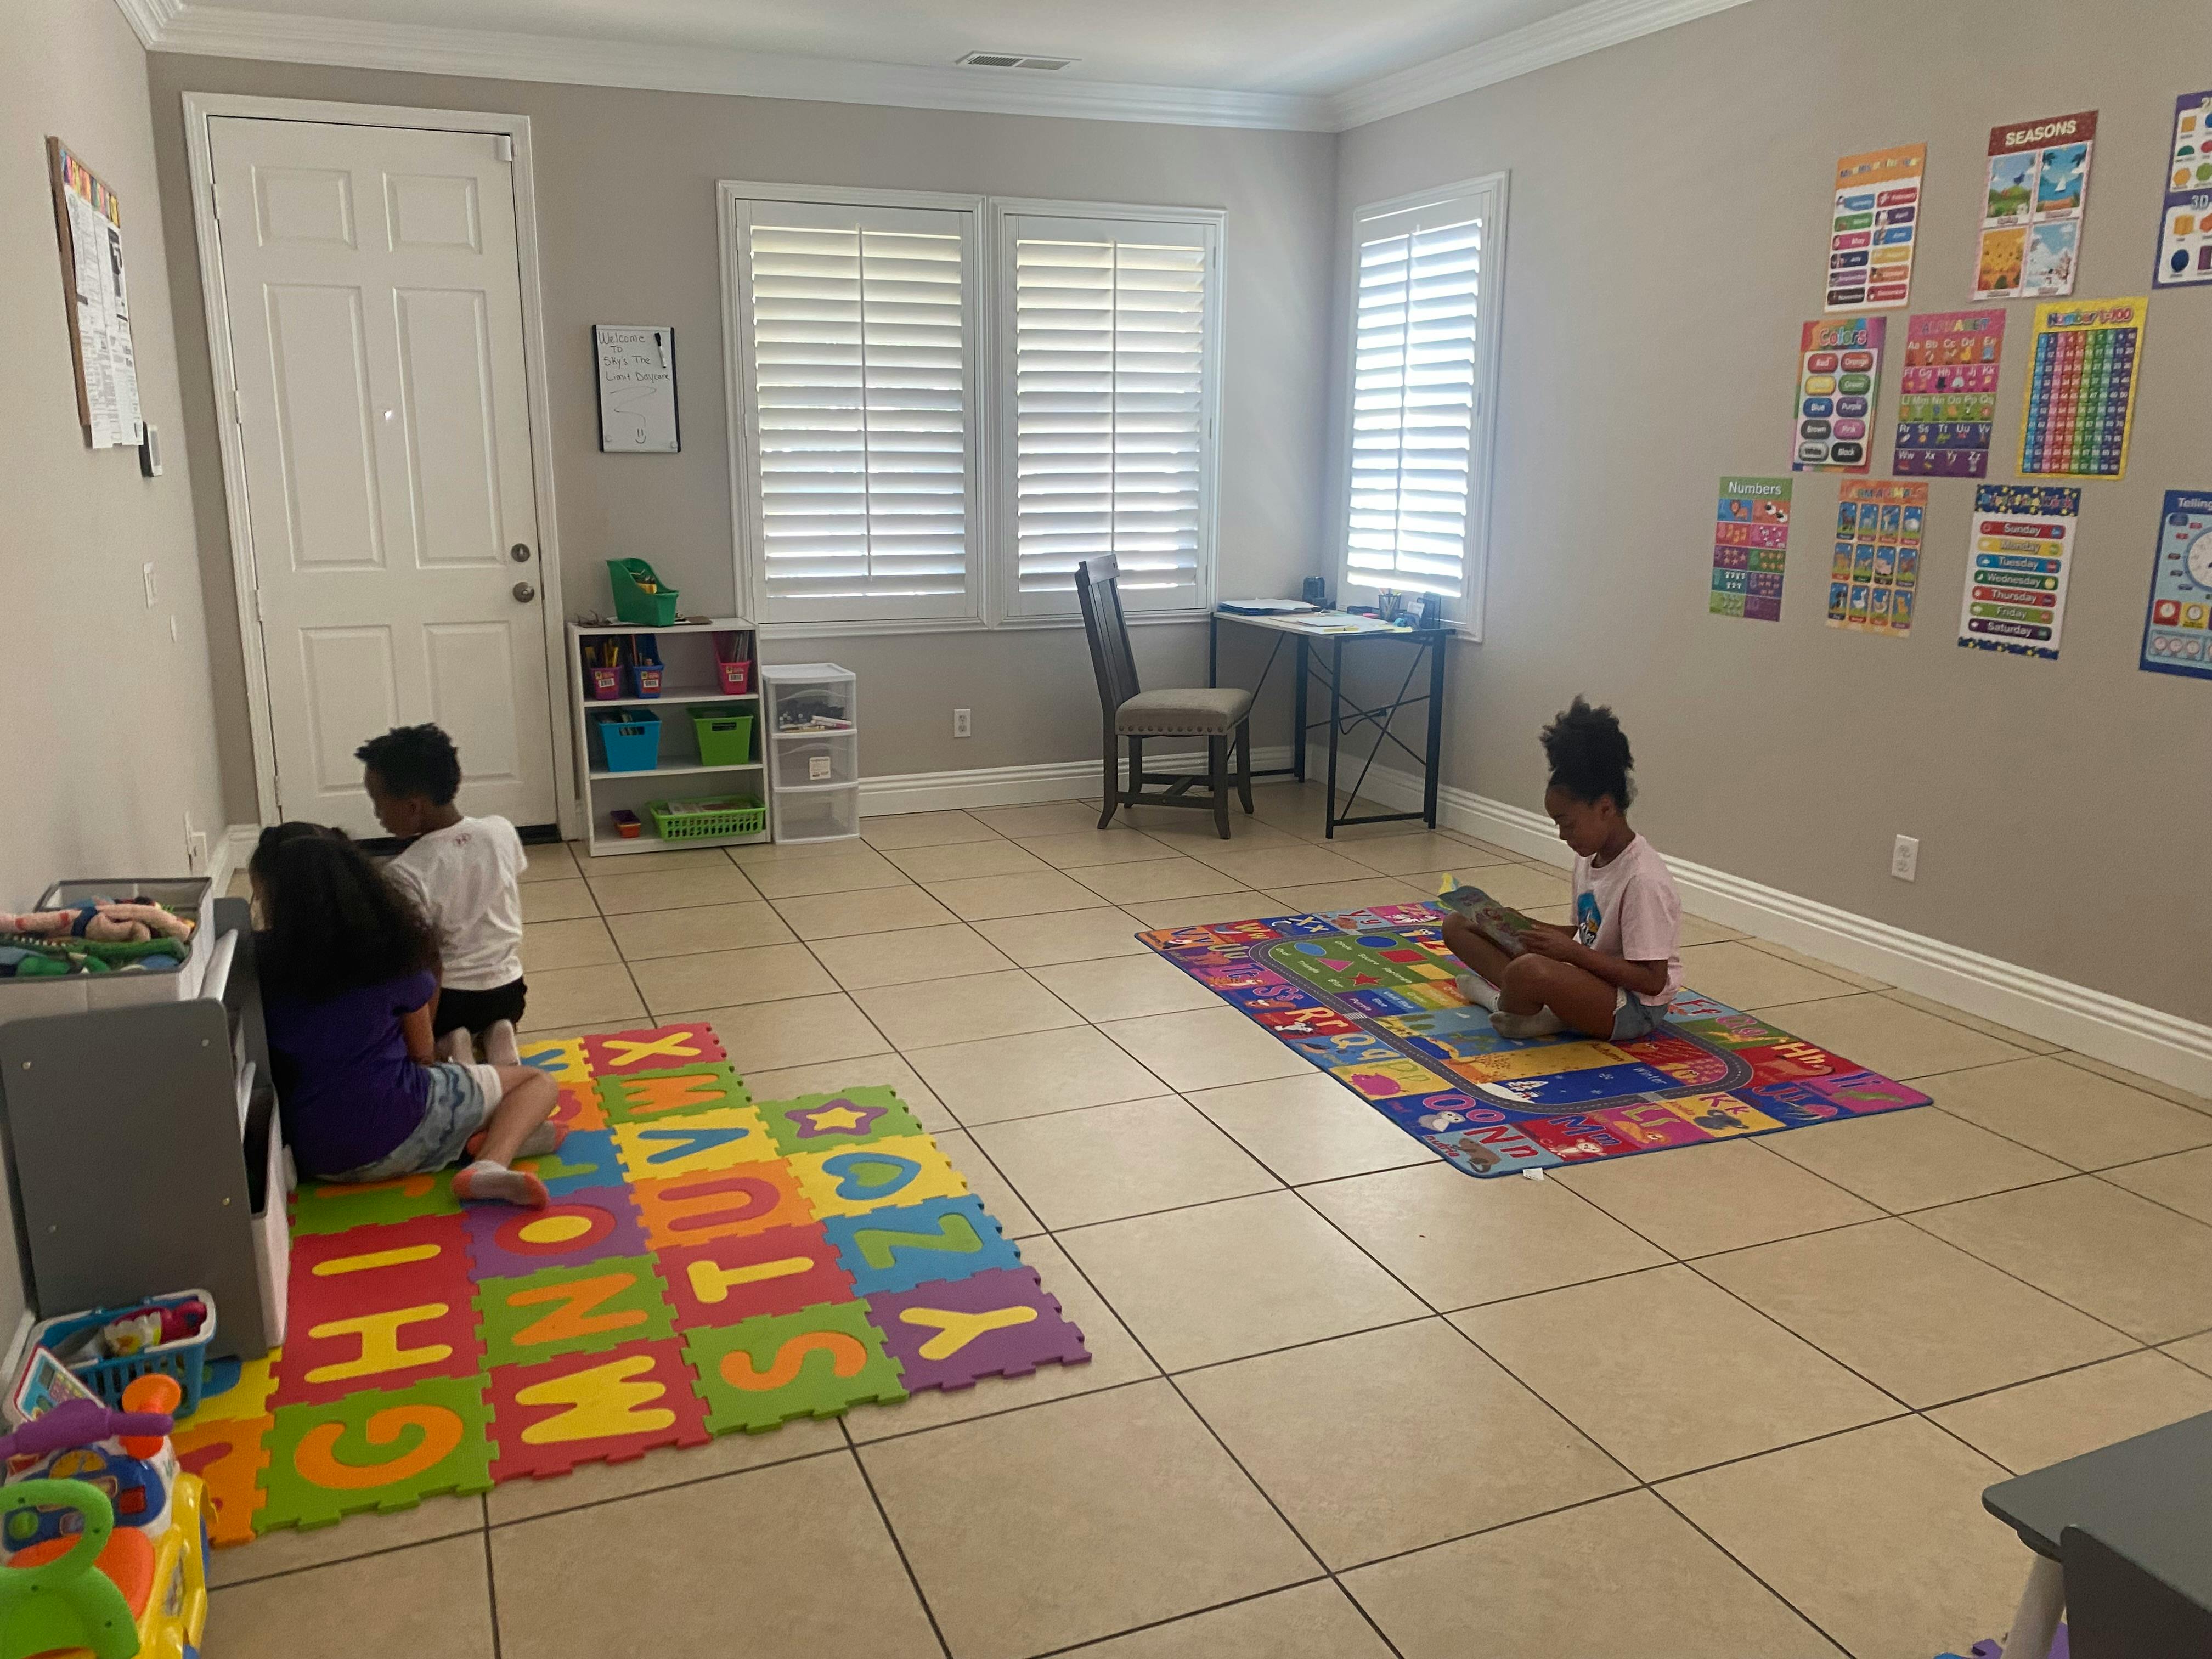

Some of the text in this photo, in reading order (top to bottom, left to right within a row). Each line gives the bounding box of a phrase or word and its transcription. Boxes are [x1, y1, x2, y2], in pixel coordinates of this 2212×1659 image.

[2005, 120, 2076, 146] SEASONS
[2047, 311, 2096, 327] Number
[598, 331, 646, 345] Welcome
[1819, 326, 1867, 346] Colors
[1909, 341, 1920, 349] Aa
[1926, 340, 1938, 349] Bb
[1944, 338, 1956, 348] Cc
[1961, 337, 1975, 347] Dd
[603, 356, 651, 369] Sky's The
[606, 371, 670, 383] Limit Daycare
[1919, 368, 1932, 379] Gg
[1811, 403, 1862, 411] Blue Purple
[1807, 425, 1827, 433] Brown
[1918, 424, 1929, 433] Ss
[1938, 424, 1948, 432] Tt
[1956, 424, 1970, 433] Uu
[1979, 424, 1990, 433] Vv
[1898, 451, 1980, 463] Ww Xx Yy Zz
[1728, 481, 1782, 494] Numbers
[2004, 523, 2041, 537] Sunday
[2000, 540, 2041, 554] Monday
[1999, 557, 2039, 570] Tuesday
[1987, 573, 2041, 588] Wednesday
[1991, 589, 2036, 603] Thursday
[1997, 606, 2027, 619] Friday
[1987, 622, 2032, 637] Saturday
[1287, 916, 1329, 933] Xx
[1253, 985, 1305, 1001] Ss
[1350, 998, 1372, 1011] Purple
[1285, 1007, 1349, 1029] Rr
[601, 1031, 702, 1066] X
[1633, 1066, 1668, 1084] Winter
[1422, 1094, 1506, 1123] Oo
[1699, 1093, 1750, 1115] Kk
[1548, 1115, 1622, 1146] Mm
[637, 1128, 749, 1164] V
[1463, 1125, 1539, 1158] Nn
[658, 1176, 780, 1232] U
[494, 1205, 616, 1256] O
[853, 1212, 984, 1270] Z
[311, 1244, 442, 1276] I
[686, 1256, 815, 1304] T
[505, 1273, 649, 1346] N
[899, 1306, 1038, 1361] Y
[304, 1302, 453, 1384] H
[720, 1331, 868, 1391] S
[294, 1404, 464, 1489] G
